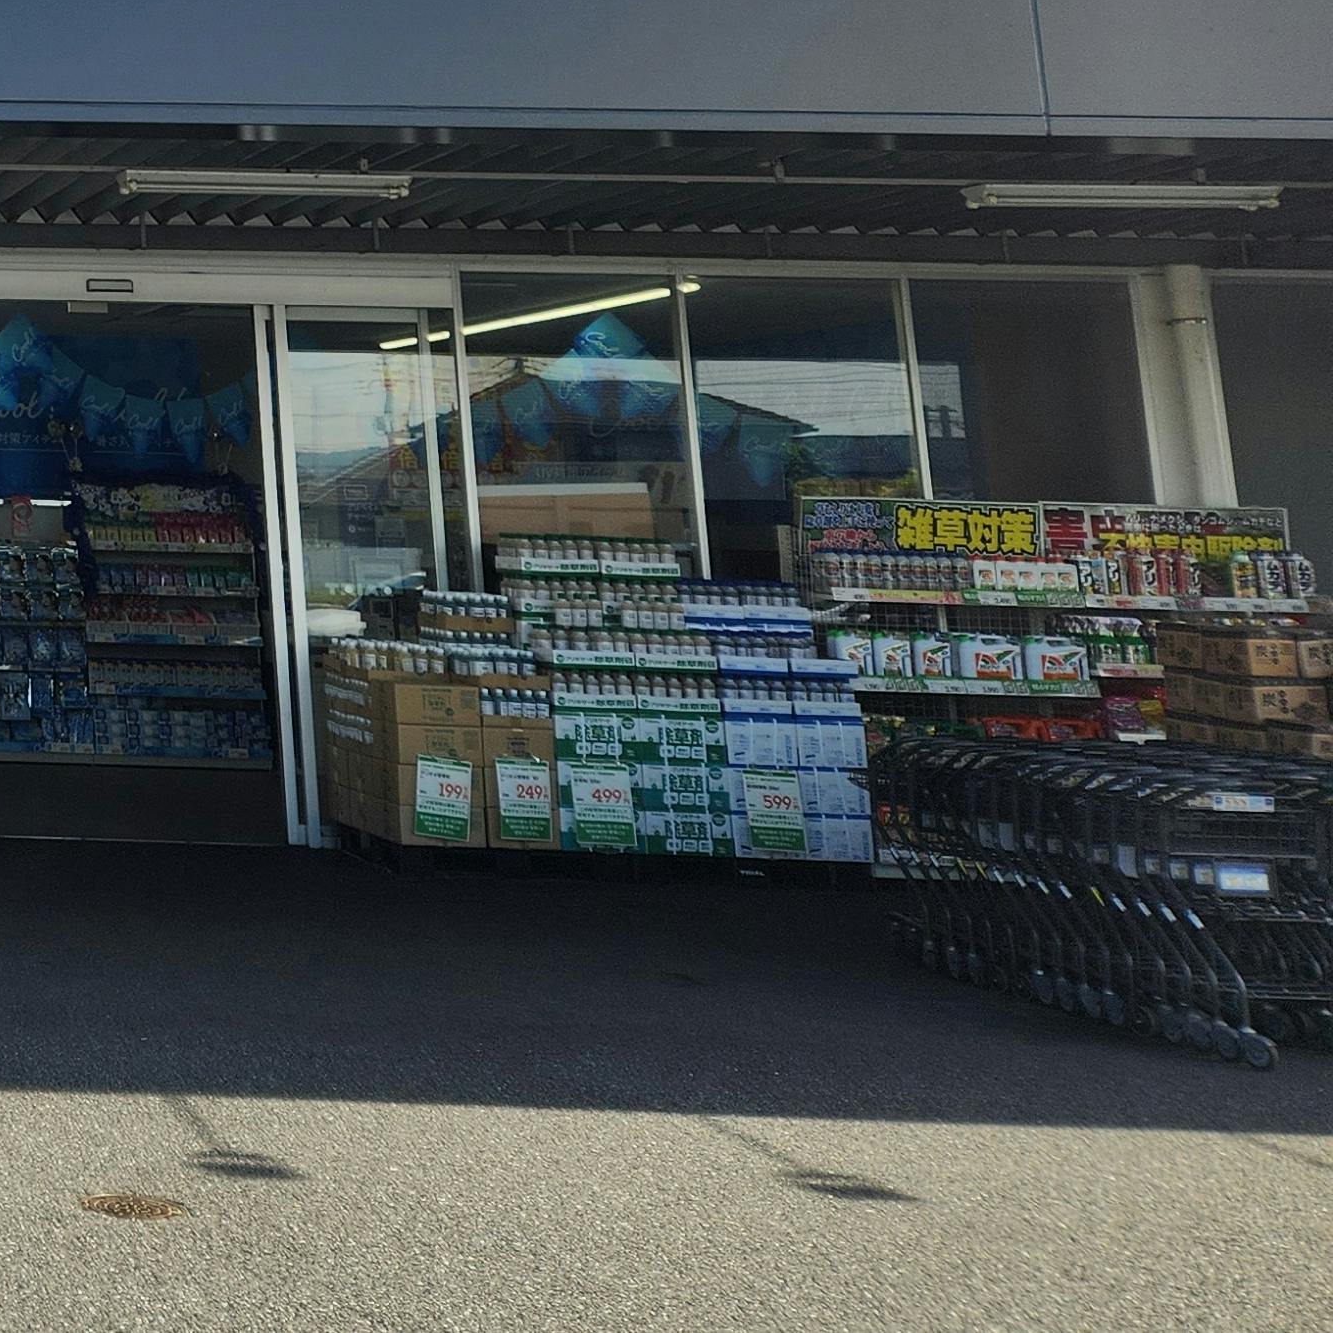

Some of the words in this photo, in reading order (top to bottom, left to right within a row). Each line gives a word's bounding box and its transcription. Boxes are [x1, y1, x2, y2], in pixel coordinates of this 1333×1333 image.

[895, 505, 1037, 555] 雑草対策
[439, 782, 462, 799] 199
[516, 784, 543, 800] 249
[592, 788, 622, 804] 499
[763, 794, 792, 810] 599
